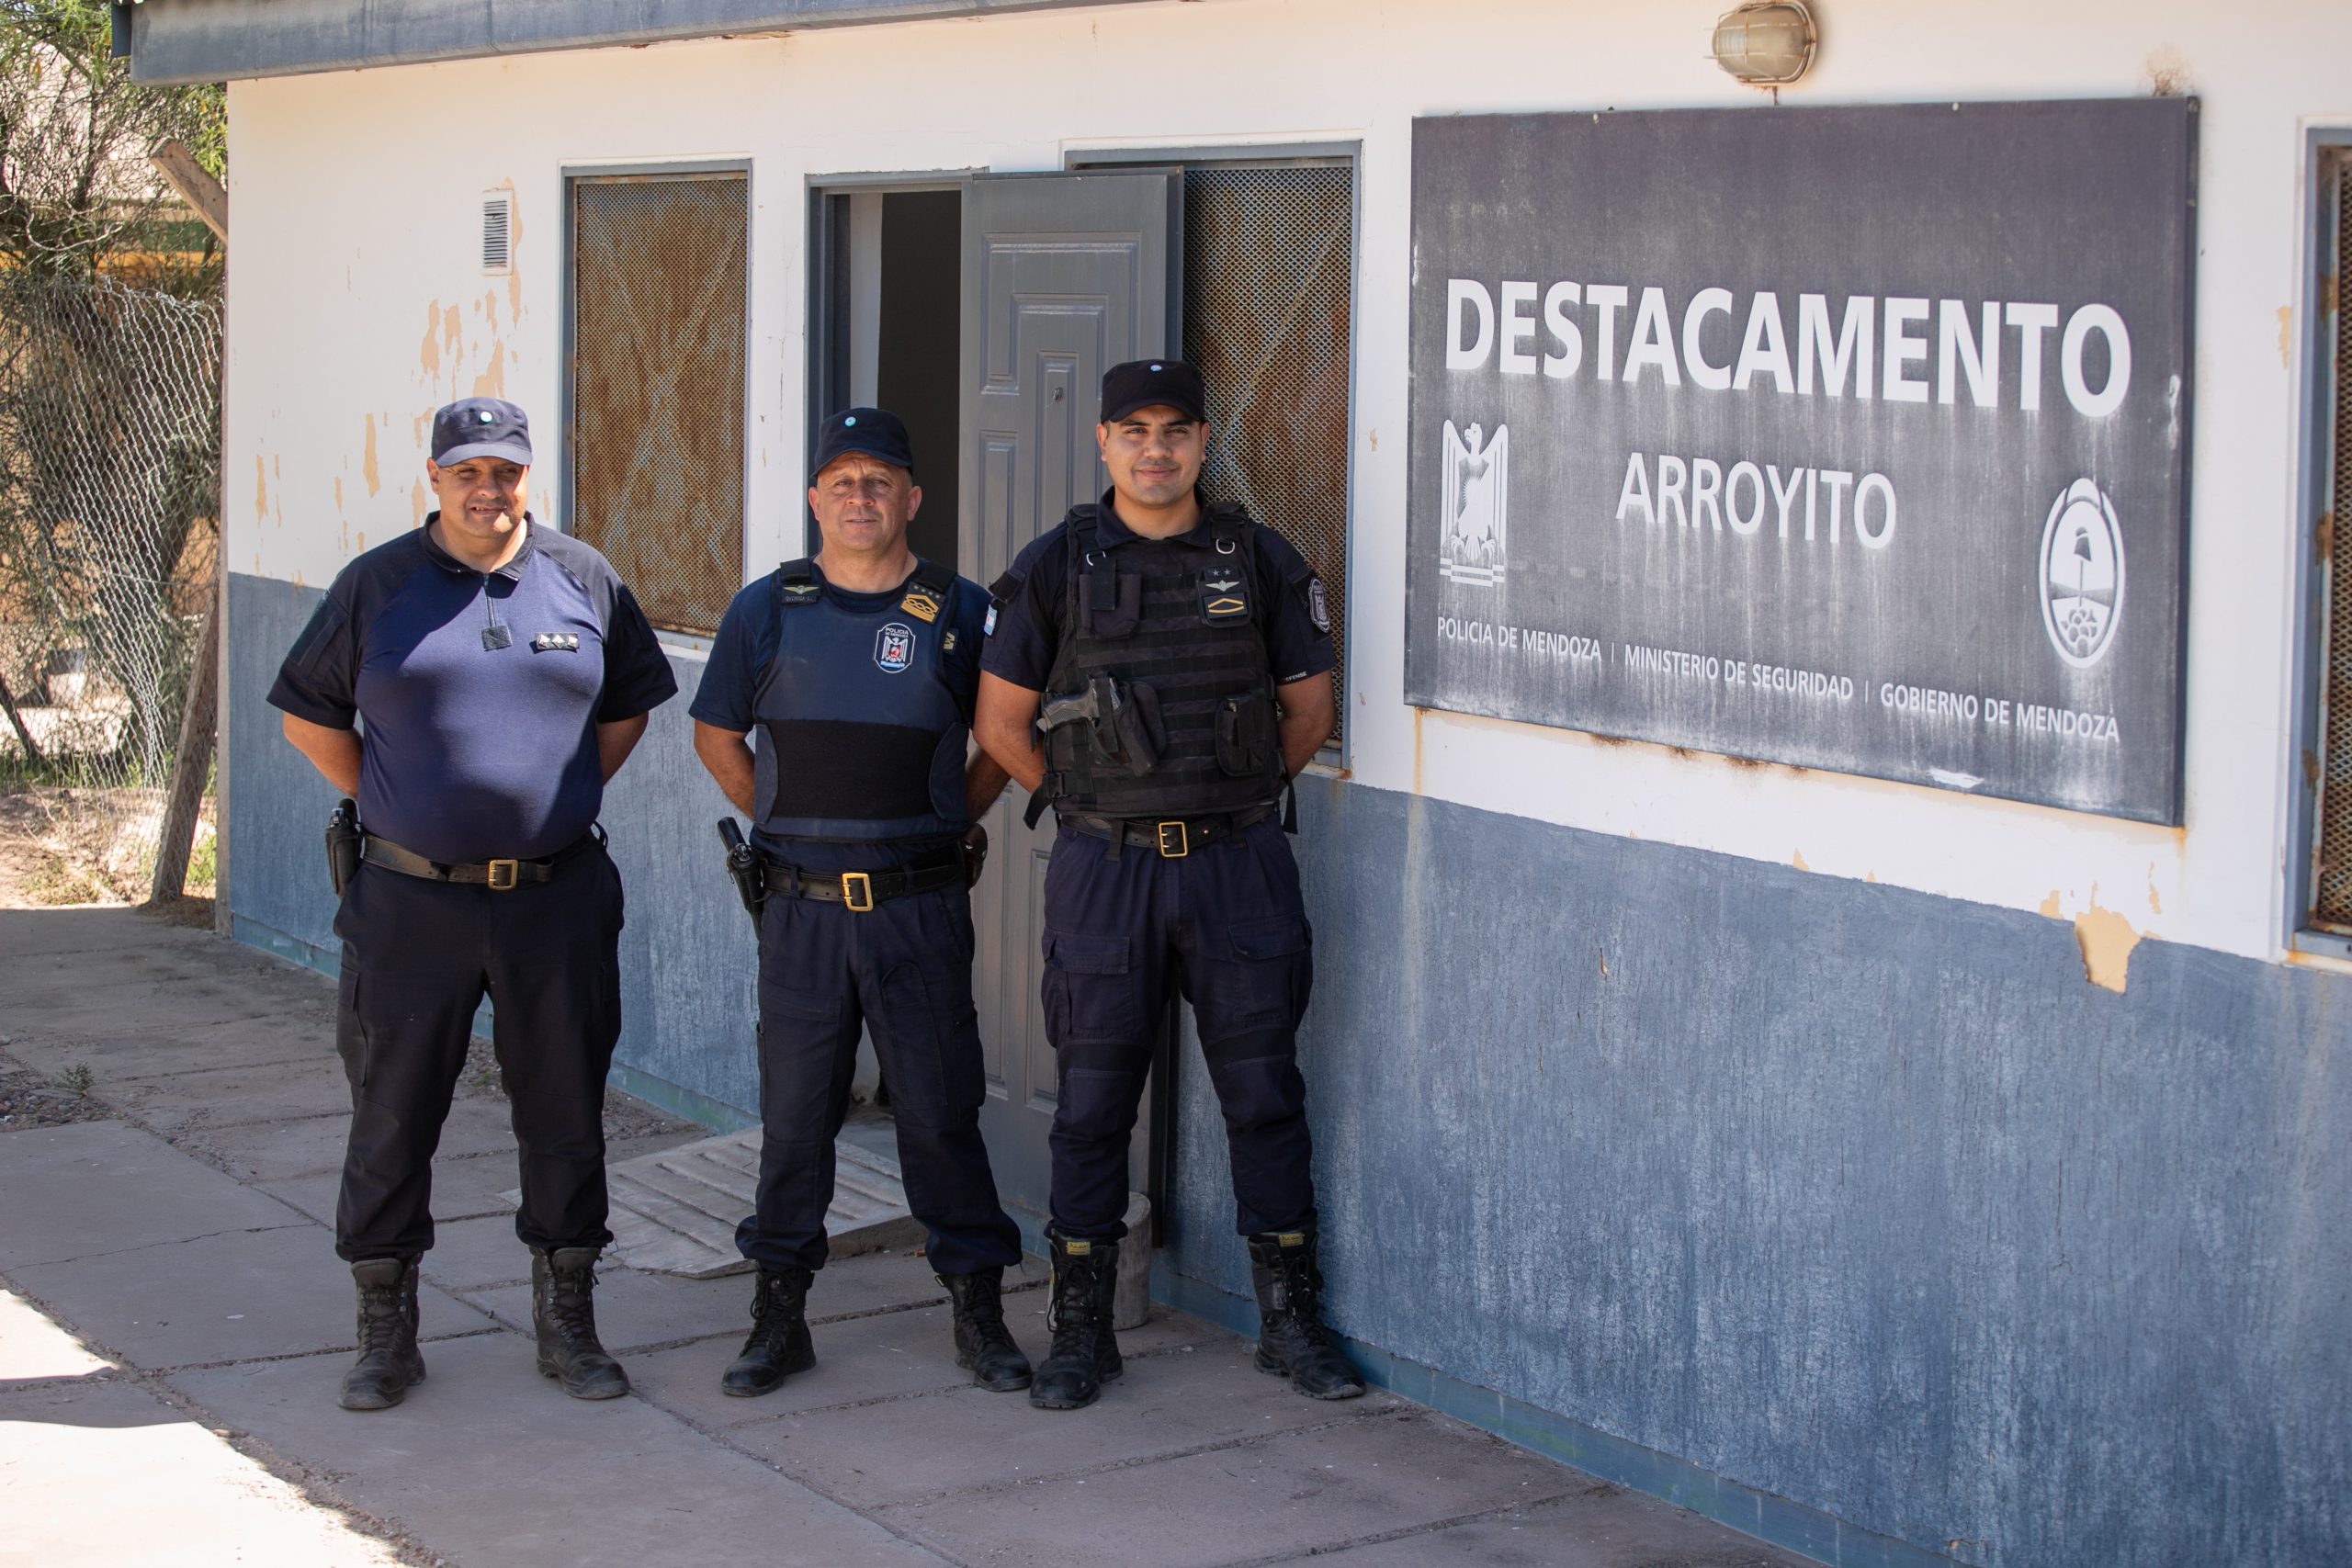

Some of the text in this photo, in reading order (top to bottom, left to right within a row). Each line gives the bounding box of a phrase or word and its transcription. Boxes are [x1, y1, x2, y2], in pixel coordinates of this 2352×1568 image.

[1445, 278, 2132, 417] DESTACAMENTO
[1616, 452, 1897, 549] ARROYITO
[1437, 617, 2120, 743] POLICIA DE MENDOZA MINISTERIO DE SEGURIDAD GOBIERNO DE MENDOZA
